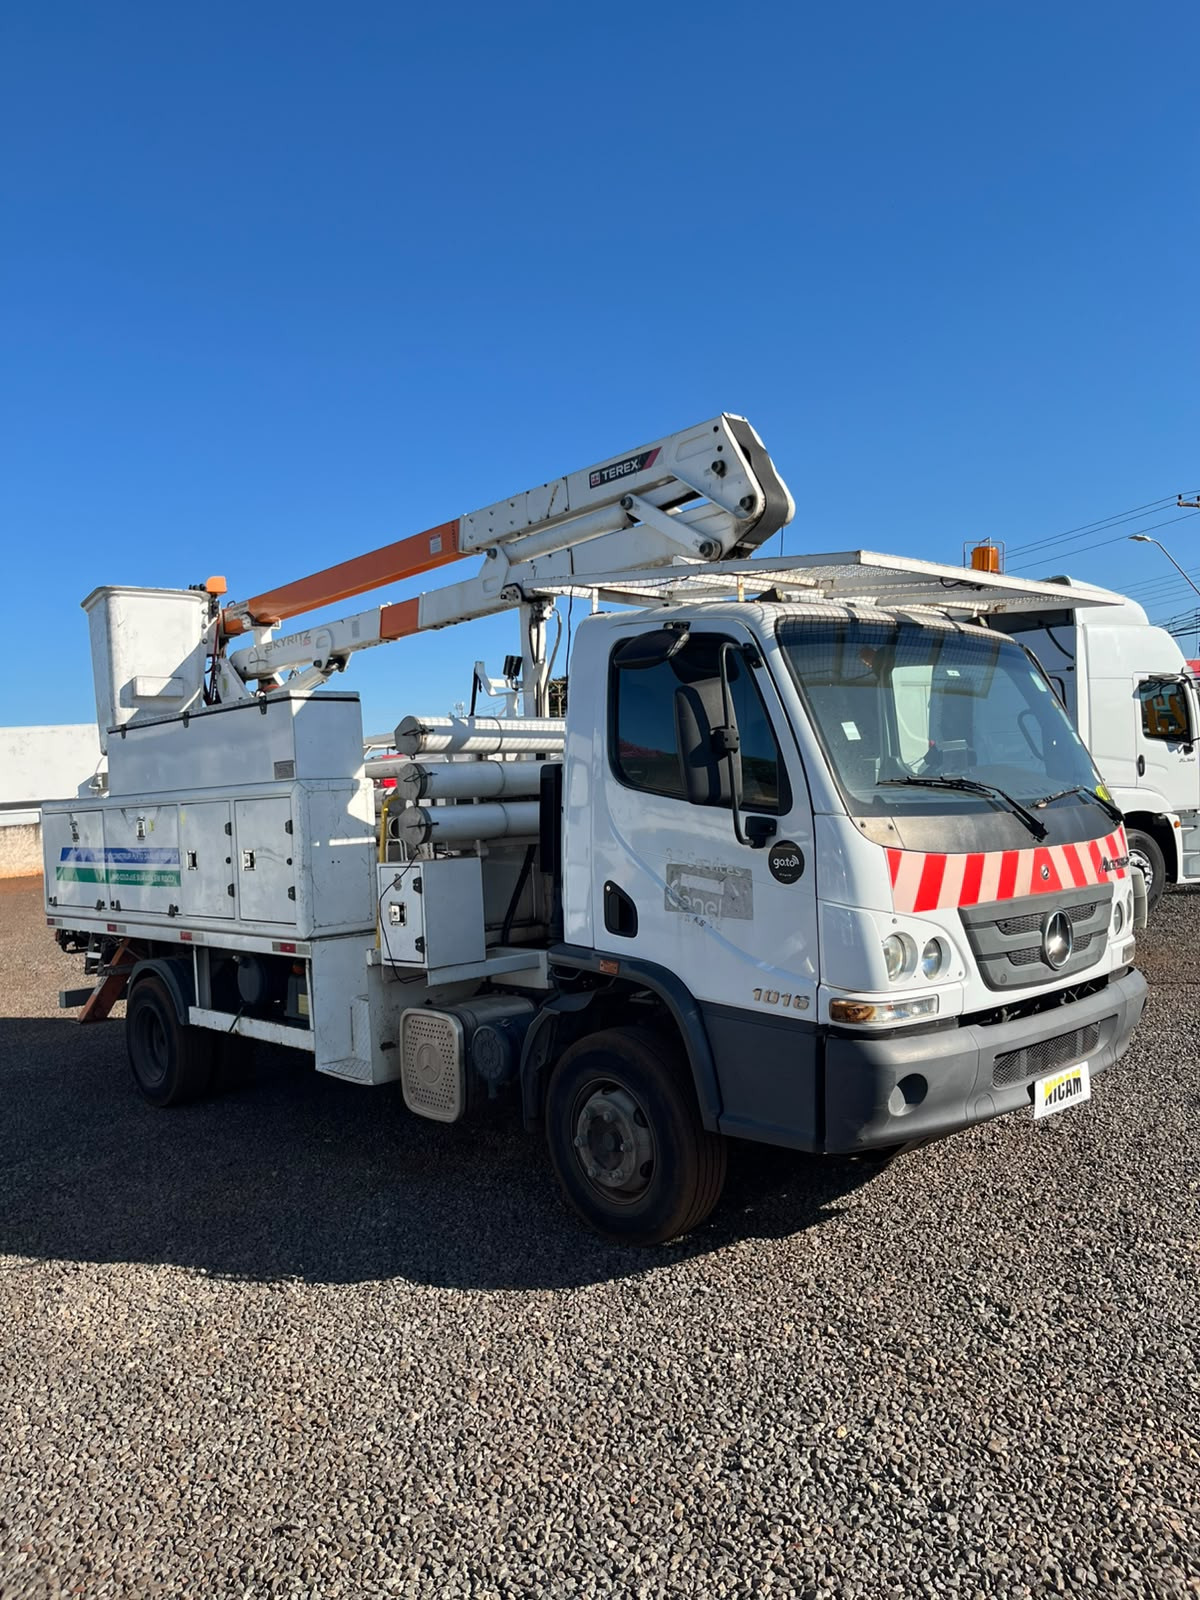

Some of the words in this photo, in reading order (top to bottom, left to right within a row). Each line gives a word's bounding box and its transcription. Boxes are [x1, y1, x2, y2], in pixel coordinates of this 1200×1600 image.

[602, 459, 639, 481] TEREX
[752, 987, 810, 1010] 1016
[1044, 1069, 1082, 1106] NICAM
